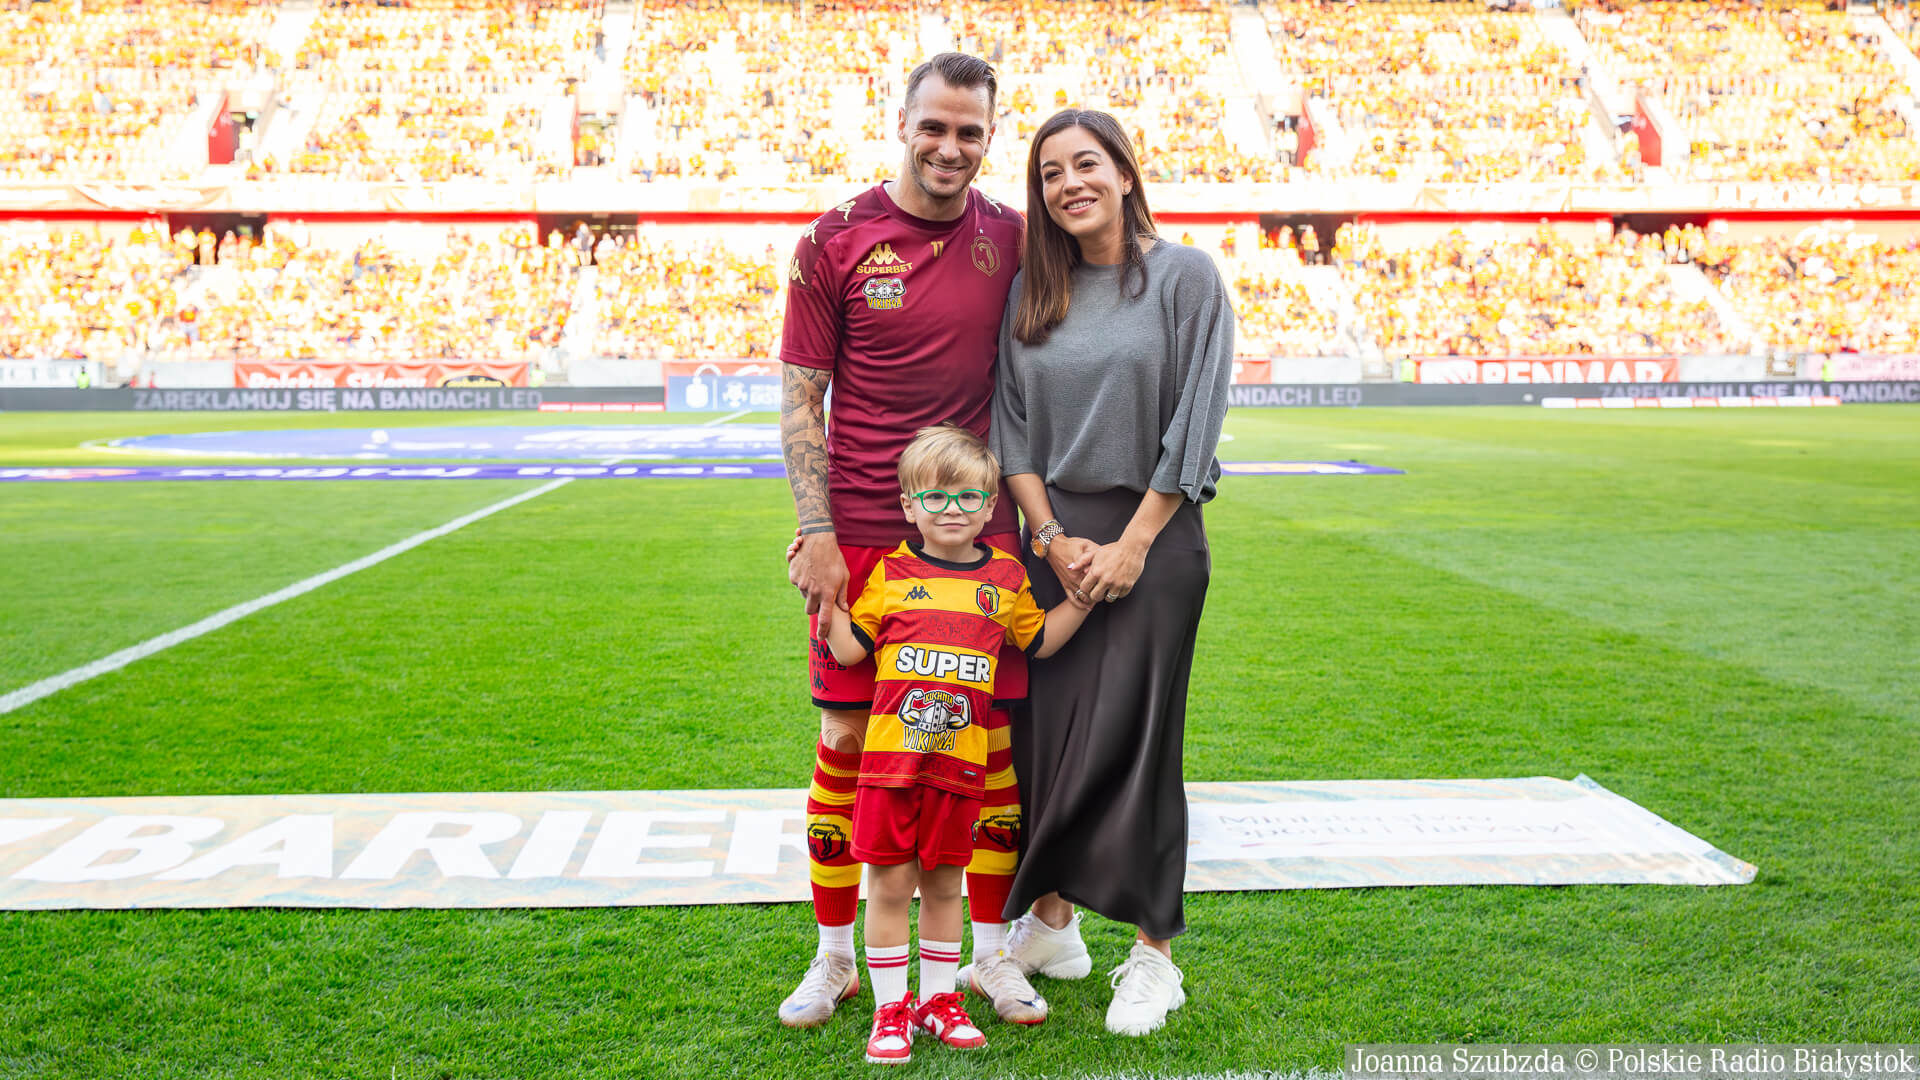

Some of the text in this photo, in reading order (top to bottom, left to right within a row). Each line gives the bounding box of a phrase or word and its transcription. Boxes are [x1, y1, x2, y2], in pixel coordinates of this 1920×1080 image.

[930, 240, 944, 257] 11
[856, 262, 913, 275] SUPERBET
[133, 391, 542, 412] ZAREKLAMUJ SIĘ NA BANDACH LED
[1319, 387, 1361, 406] LED
[896, 645, 991, 683] SUPER
